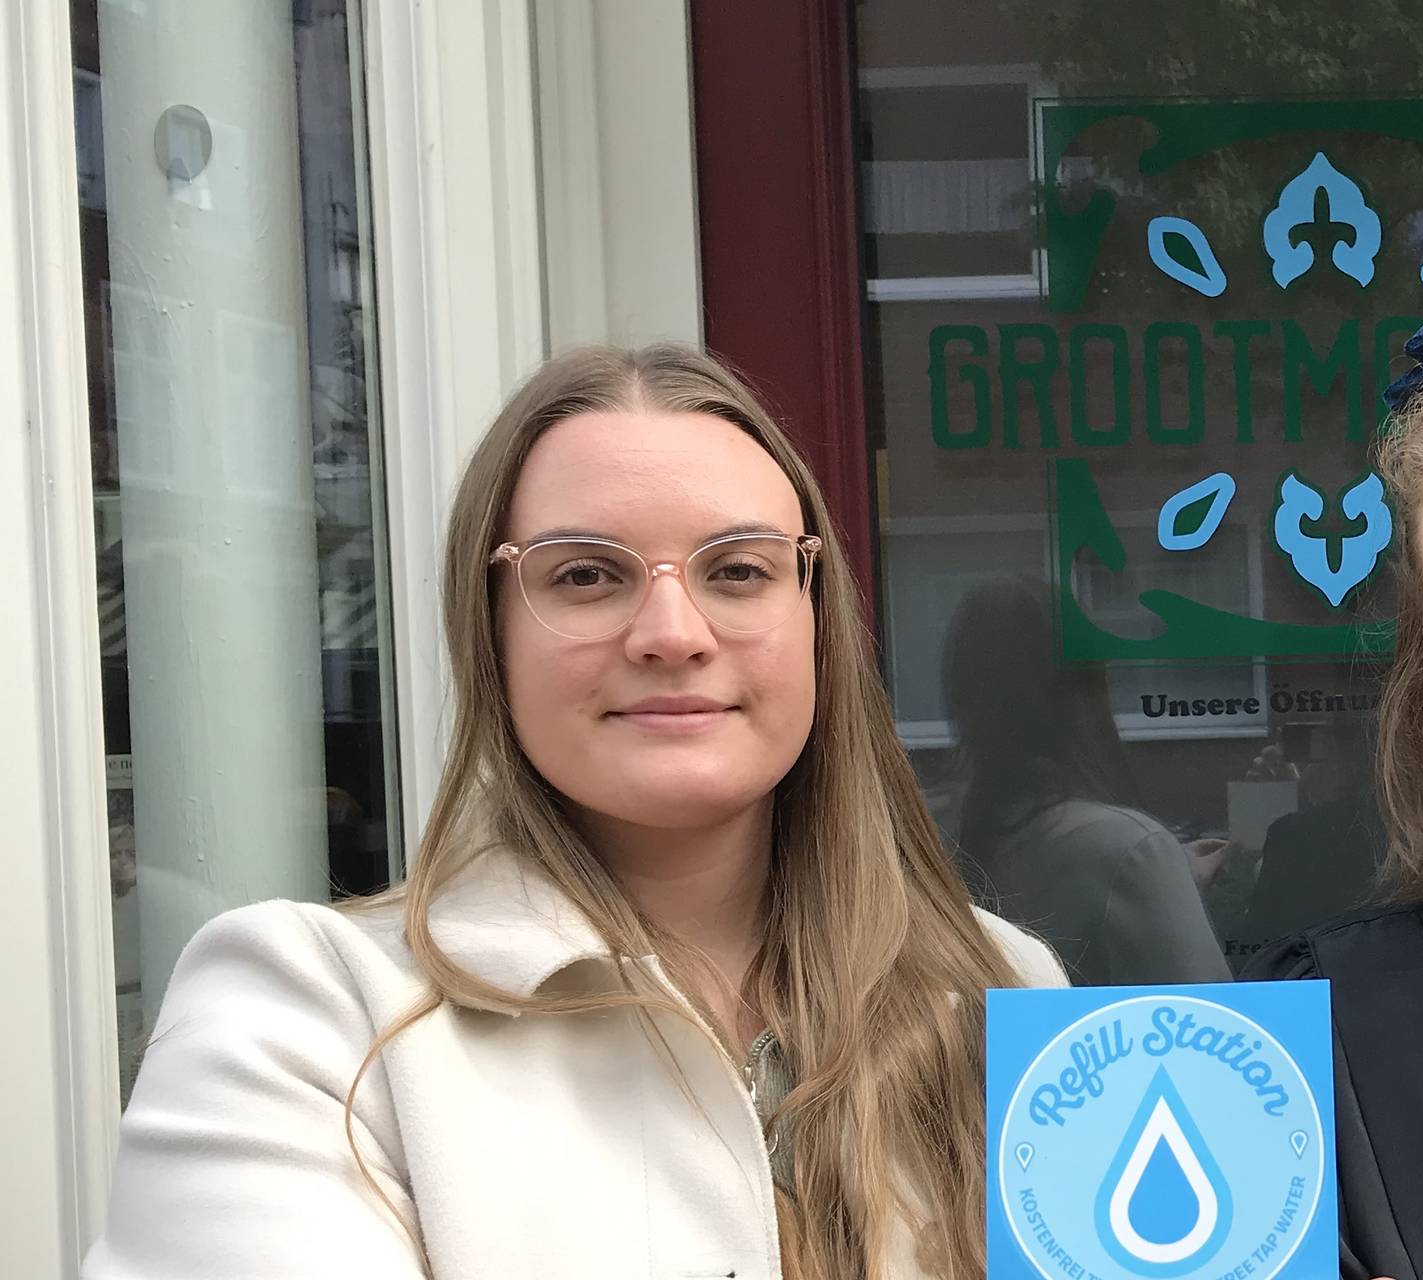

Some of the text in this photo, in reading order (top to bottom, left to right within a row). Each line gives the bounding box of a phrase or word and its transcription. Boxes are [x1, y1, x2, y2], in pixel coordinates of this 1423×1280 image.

[1141, 683, 1379, 718] Unsere Öffnu
[1224, 938, 1270, 956] Fre
[1029, 1006, 1290, 1127] Refill Station
[1019, 1187, 1086, 1280] KOSTENFREI
[1251, 1233, 1278, 1263] TAP
[1273, 1175, 1306, 1234] WATER
